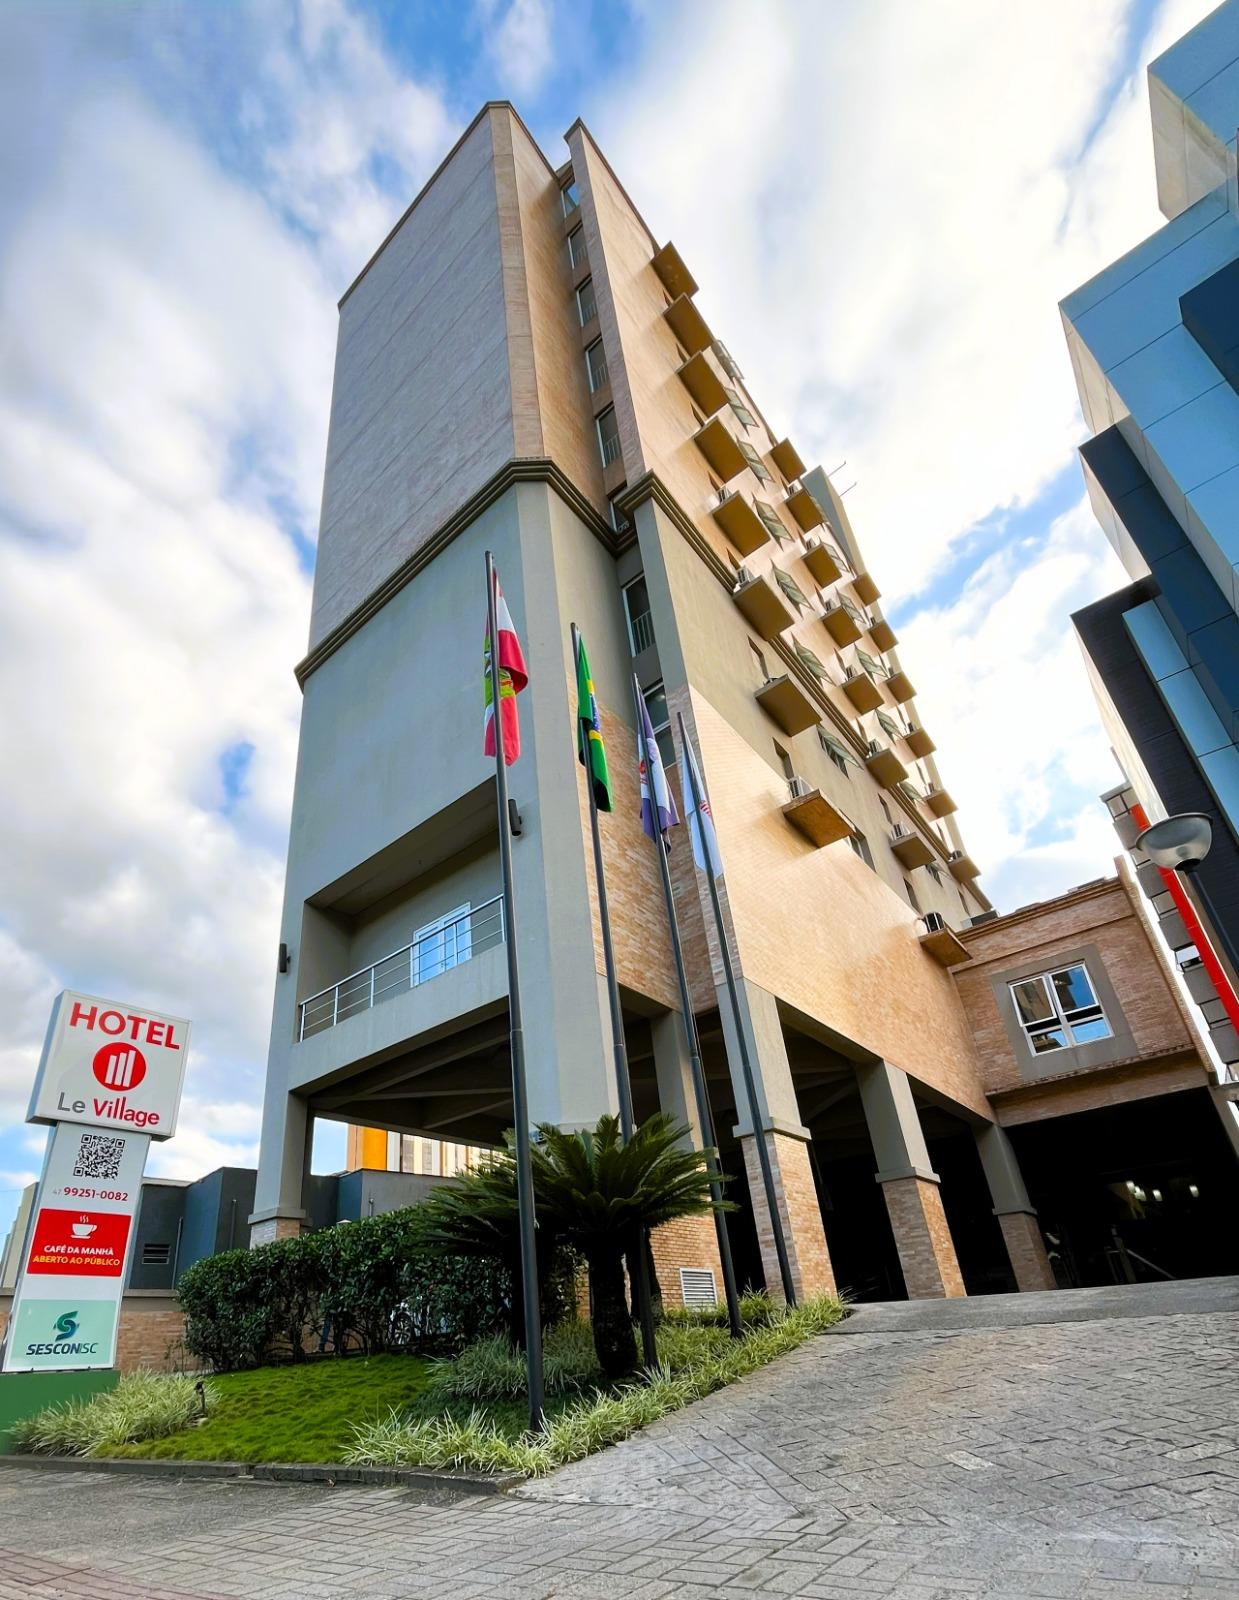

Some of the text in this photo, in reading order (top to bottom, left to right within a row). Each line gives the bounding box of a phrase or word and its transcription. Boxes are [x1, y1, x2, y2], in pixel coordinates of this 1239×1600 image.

[69, 1002, 180, 1050] HOTEL
[57, 1092, 160, 1128] Le Village
[63, 1186, 129, 1202] 99251-0082
[43, 1244, 66, 1254] CAFÉ
[67, 1246, 80, 1254] DA
[32, 1255, 68, 1264] ABERTO
